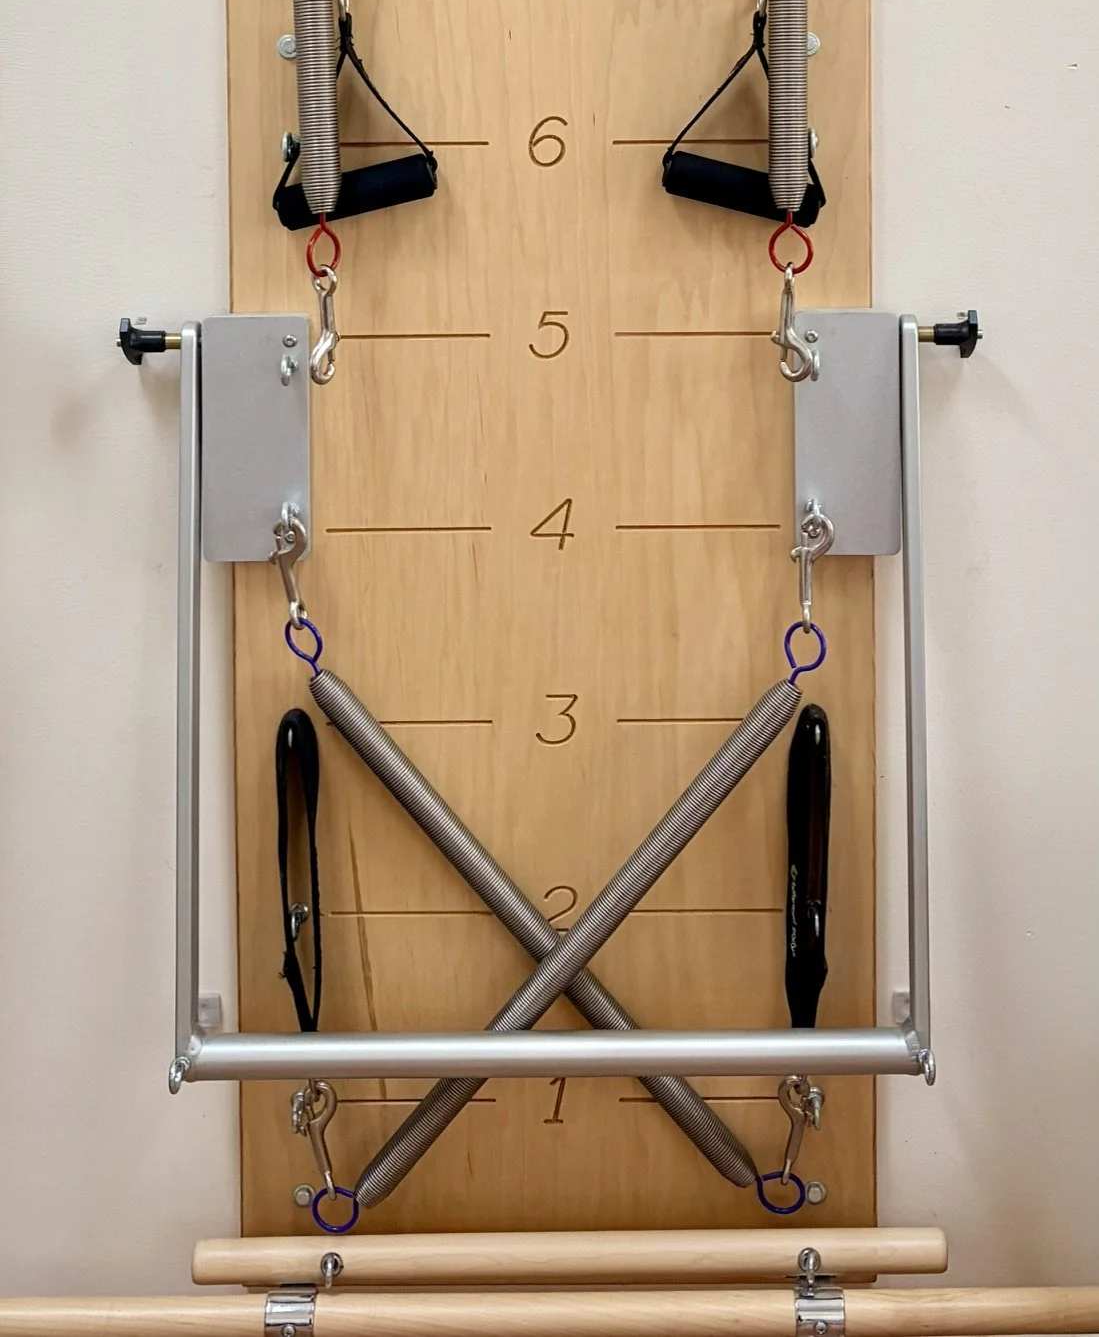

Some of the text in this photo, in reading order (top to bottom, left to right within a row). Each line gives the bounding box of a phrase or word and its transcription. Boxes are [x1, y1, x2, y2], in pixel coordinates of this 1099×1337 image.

[528, 115, 569, 168] 6
[528, 310, 570, 360] 5
[529, 498, 575, 551] 4
[535, 693, 579, 745] 3
[543, 885, 578, 933] 2
[543, 1076, 566, 1125] 1
